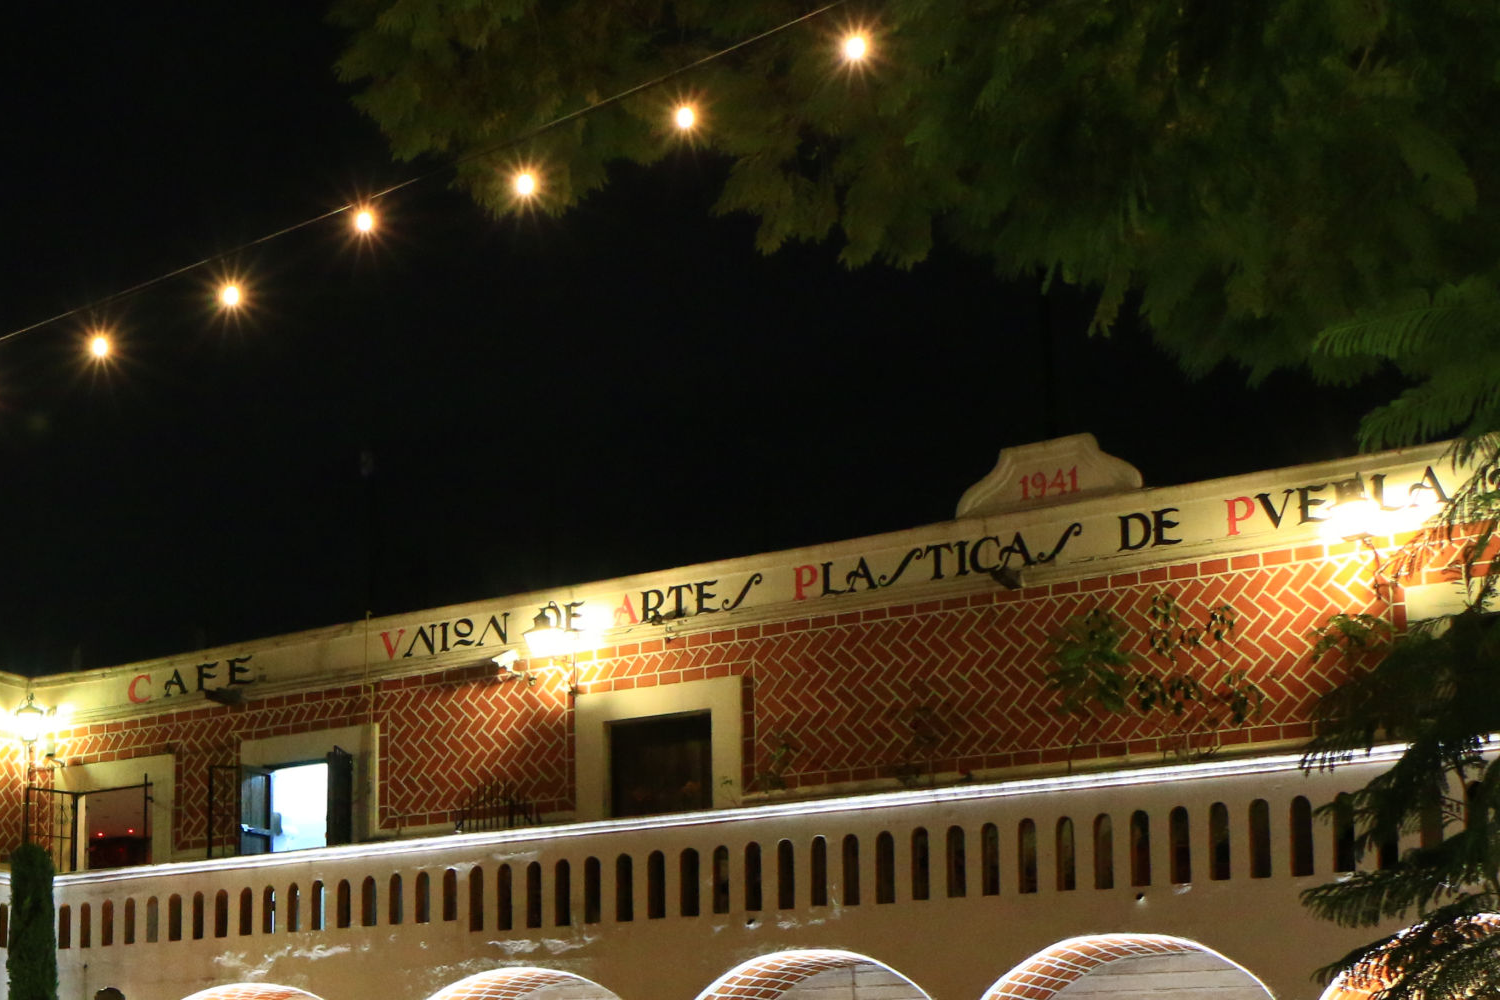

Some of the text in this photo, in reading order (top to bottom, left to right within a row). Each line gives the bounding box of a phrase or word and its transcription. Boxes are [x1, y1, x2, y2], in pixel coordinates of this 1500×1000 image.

[1019, 465, 1081, 501] 1941
[614, 572, 763, 626] ARTES
[792, 522, 1082, 601] PLASTICAS
[1117, 508, 1183, 552] DE
[127, 655, 255, 704] CAFE
